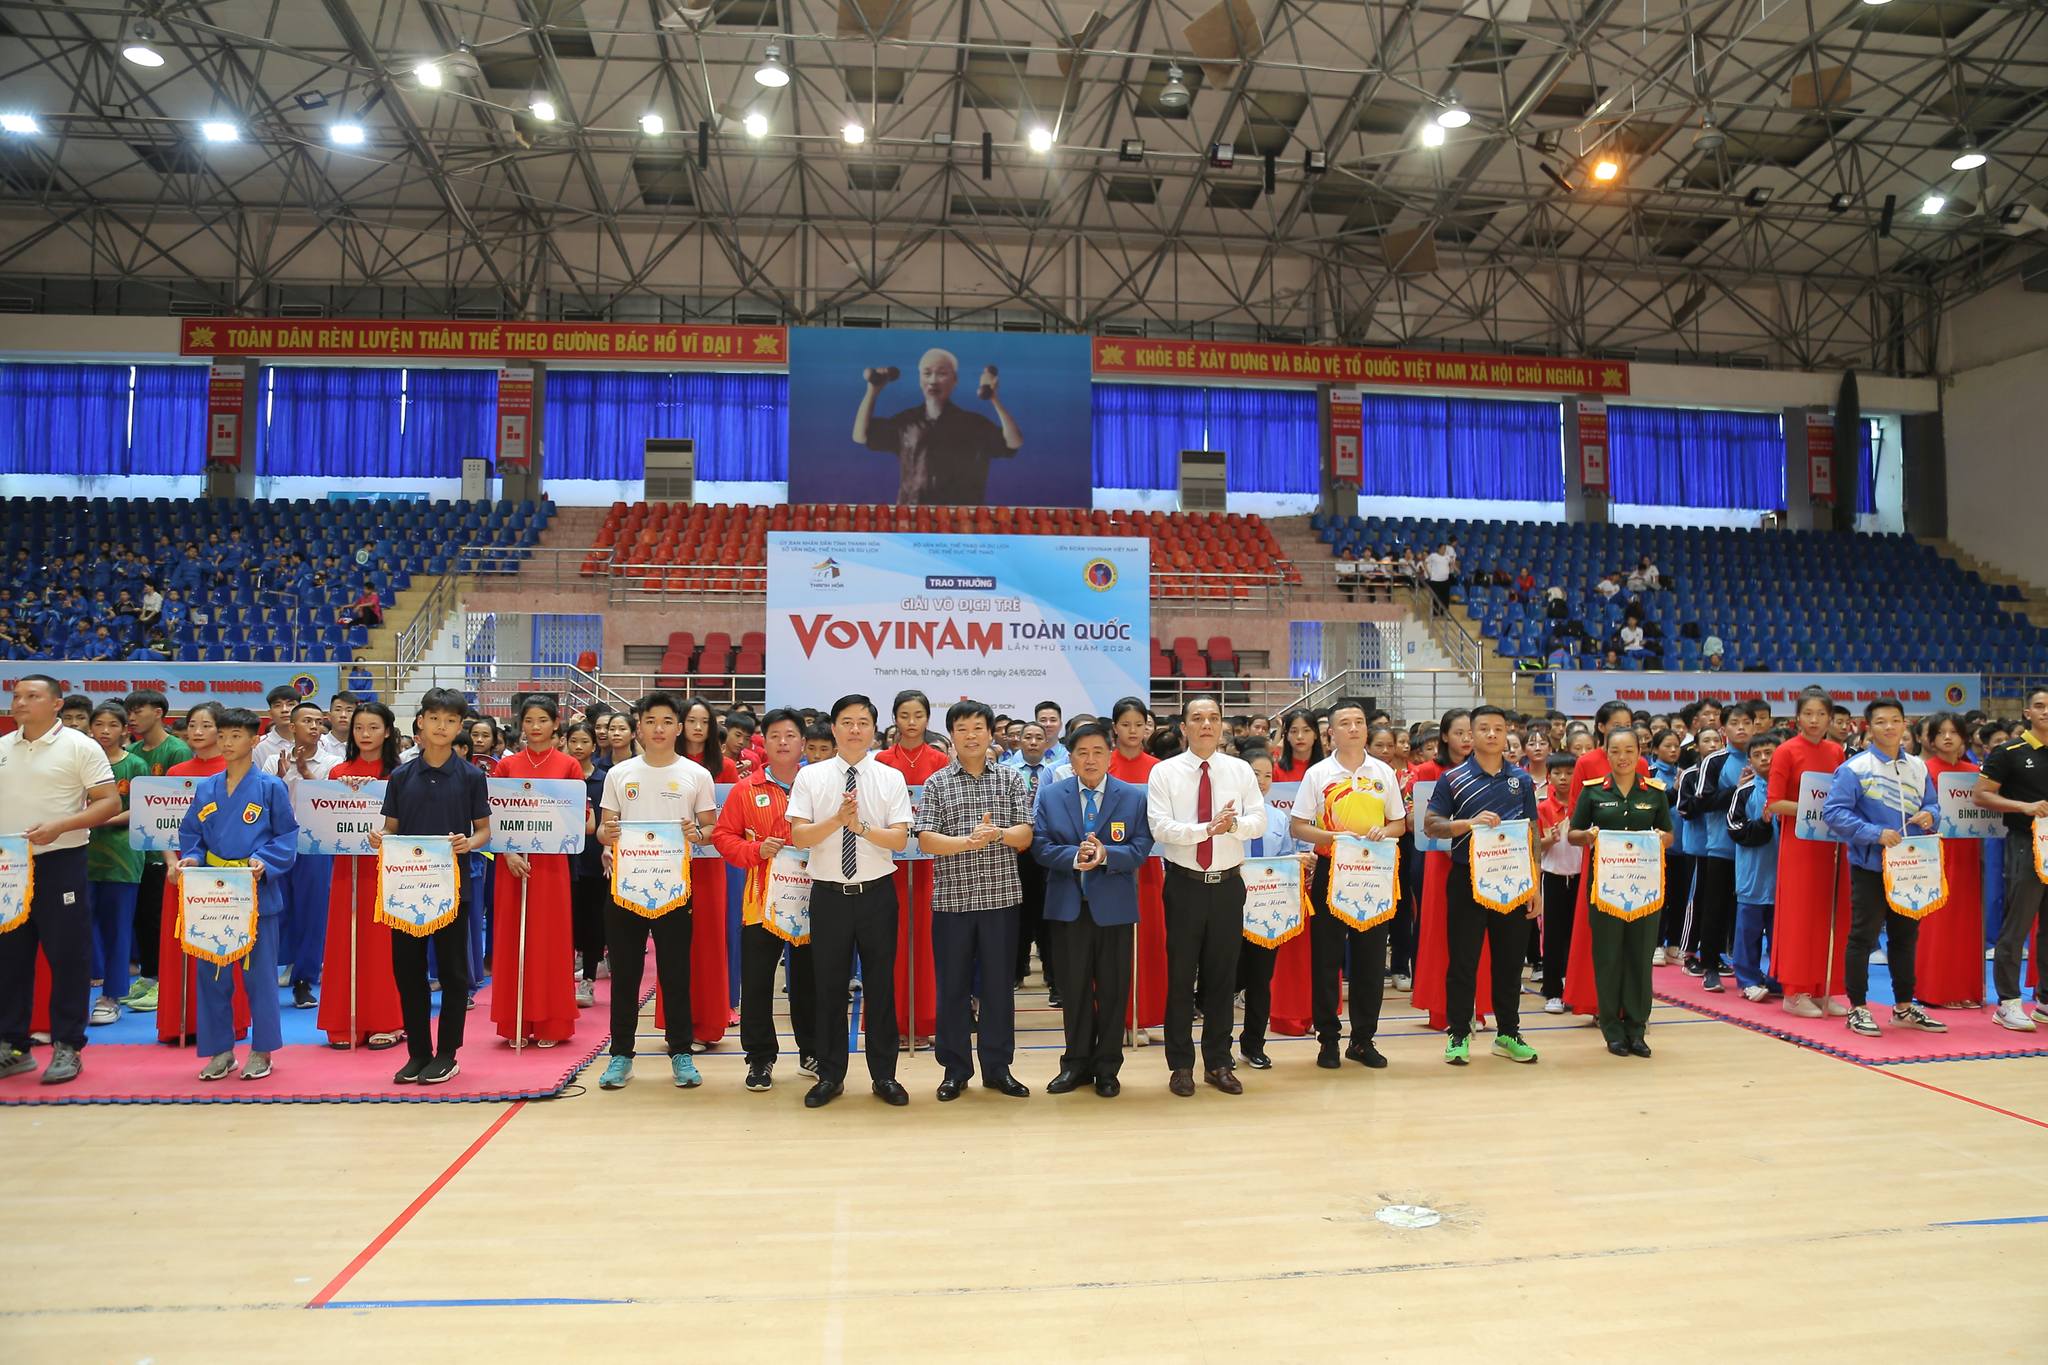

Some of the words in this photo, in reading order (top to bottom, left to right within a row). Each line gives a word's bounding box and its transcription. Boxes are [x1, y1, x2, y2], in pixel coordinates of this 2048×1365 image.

[228, 326, 272, 348] TOÀN
[278, 326, 315, 348] DÂN
[318, 327, 354, 348] RÈN
[359, 327, 414, 352] LUYỆN
[418, 327, 464, 350] THÂN
[469, 325, 500, 350] THỂ
[505, 332, 548, 350] THEO
[553, 330, 609, 352] GƯƠNG
[615, 330, 648, 352] BÁC
[681, 332, 699, 353] VĨ
[703, 335, 731, 357] ĐẠI
[1136, 345, 1173, 367] KHỎE
[1177, 345, 1197, 368] ĐỂ
[1200, 349, 1227, 369] XÂY
[1230, 351, 1268, 374] DỰNG
[1272, 351, 1290, 372] VÀ
[1293, 351, 1320, 374] BẢO
[1324, 353, 1341, 378] VỆ
[1345, 353, 1361, 376] TỔ
[1365, 354, 1399, 377] QUỐC
[1404, 358, 1432, 381] VIỆT
[1436, 363, 1467, 381] NAM
[1470, 360, 1488, 382] XÃ
[1491, 364, 1512, 386] HỘI
[1517, 363, 1542, 384] CHỦ
[1546, 365, 1585, 387] NGHĨA
[930, 579, 954, 587] TRAO
[901, 595, 928, 610] GIẢI
[959, 599, 990, 613] ĐỊCH
[995, 597, 1021, 611] TRẺ
[1010, 619, 1065, 639] TOÀN
[1074, 616, 1130, 640] QUỐC
[789, 614, 1003, 660] VOVINAM
[1007, 642, 1029, 651] LẦN
[1073, 644, 1098, 652] NĂM
[931, 668, 950, 677] ngày
[988, 669, 1006, 678] ngày
[1008, 669, 1047, 677] 24/6/2024
[83, 680, 128, 692] TRUNG
[179, 680, 205, 692] CAO
[209, 679, 262, 694] THƯỢNG
[1615, 688, 1645, 700] TOÀN
[1648, 688, 1671, 700] DÂN
[1674, 689, 1696, 701] RÈN
[1734, 689, 1762, 700] THÂN
[311, 798, 367, 810] VOVINAM
[1958, 808, 1978, 819] BÌNH
[156, 815, 182, 829] QUẢN
[337, 822, 354, 833] GIA
[357, 822, 373, 833] LAI
[500, 820, 524, 831] NAM
[527, 820, 552, 834] ĐỊNH
[620, 849, 660, 857] VOVINAM
[1477, 848, 1508, 859] VOVINAM
[385, 865, 427, 874] VOVINAM
[1337, 863, 1371, 871] VOVINAM
[773, 873, 810, 885] VOVINAM
[187, 896, 229, 904] VOVINAM
